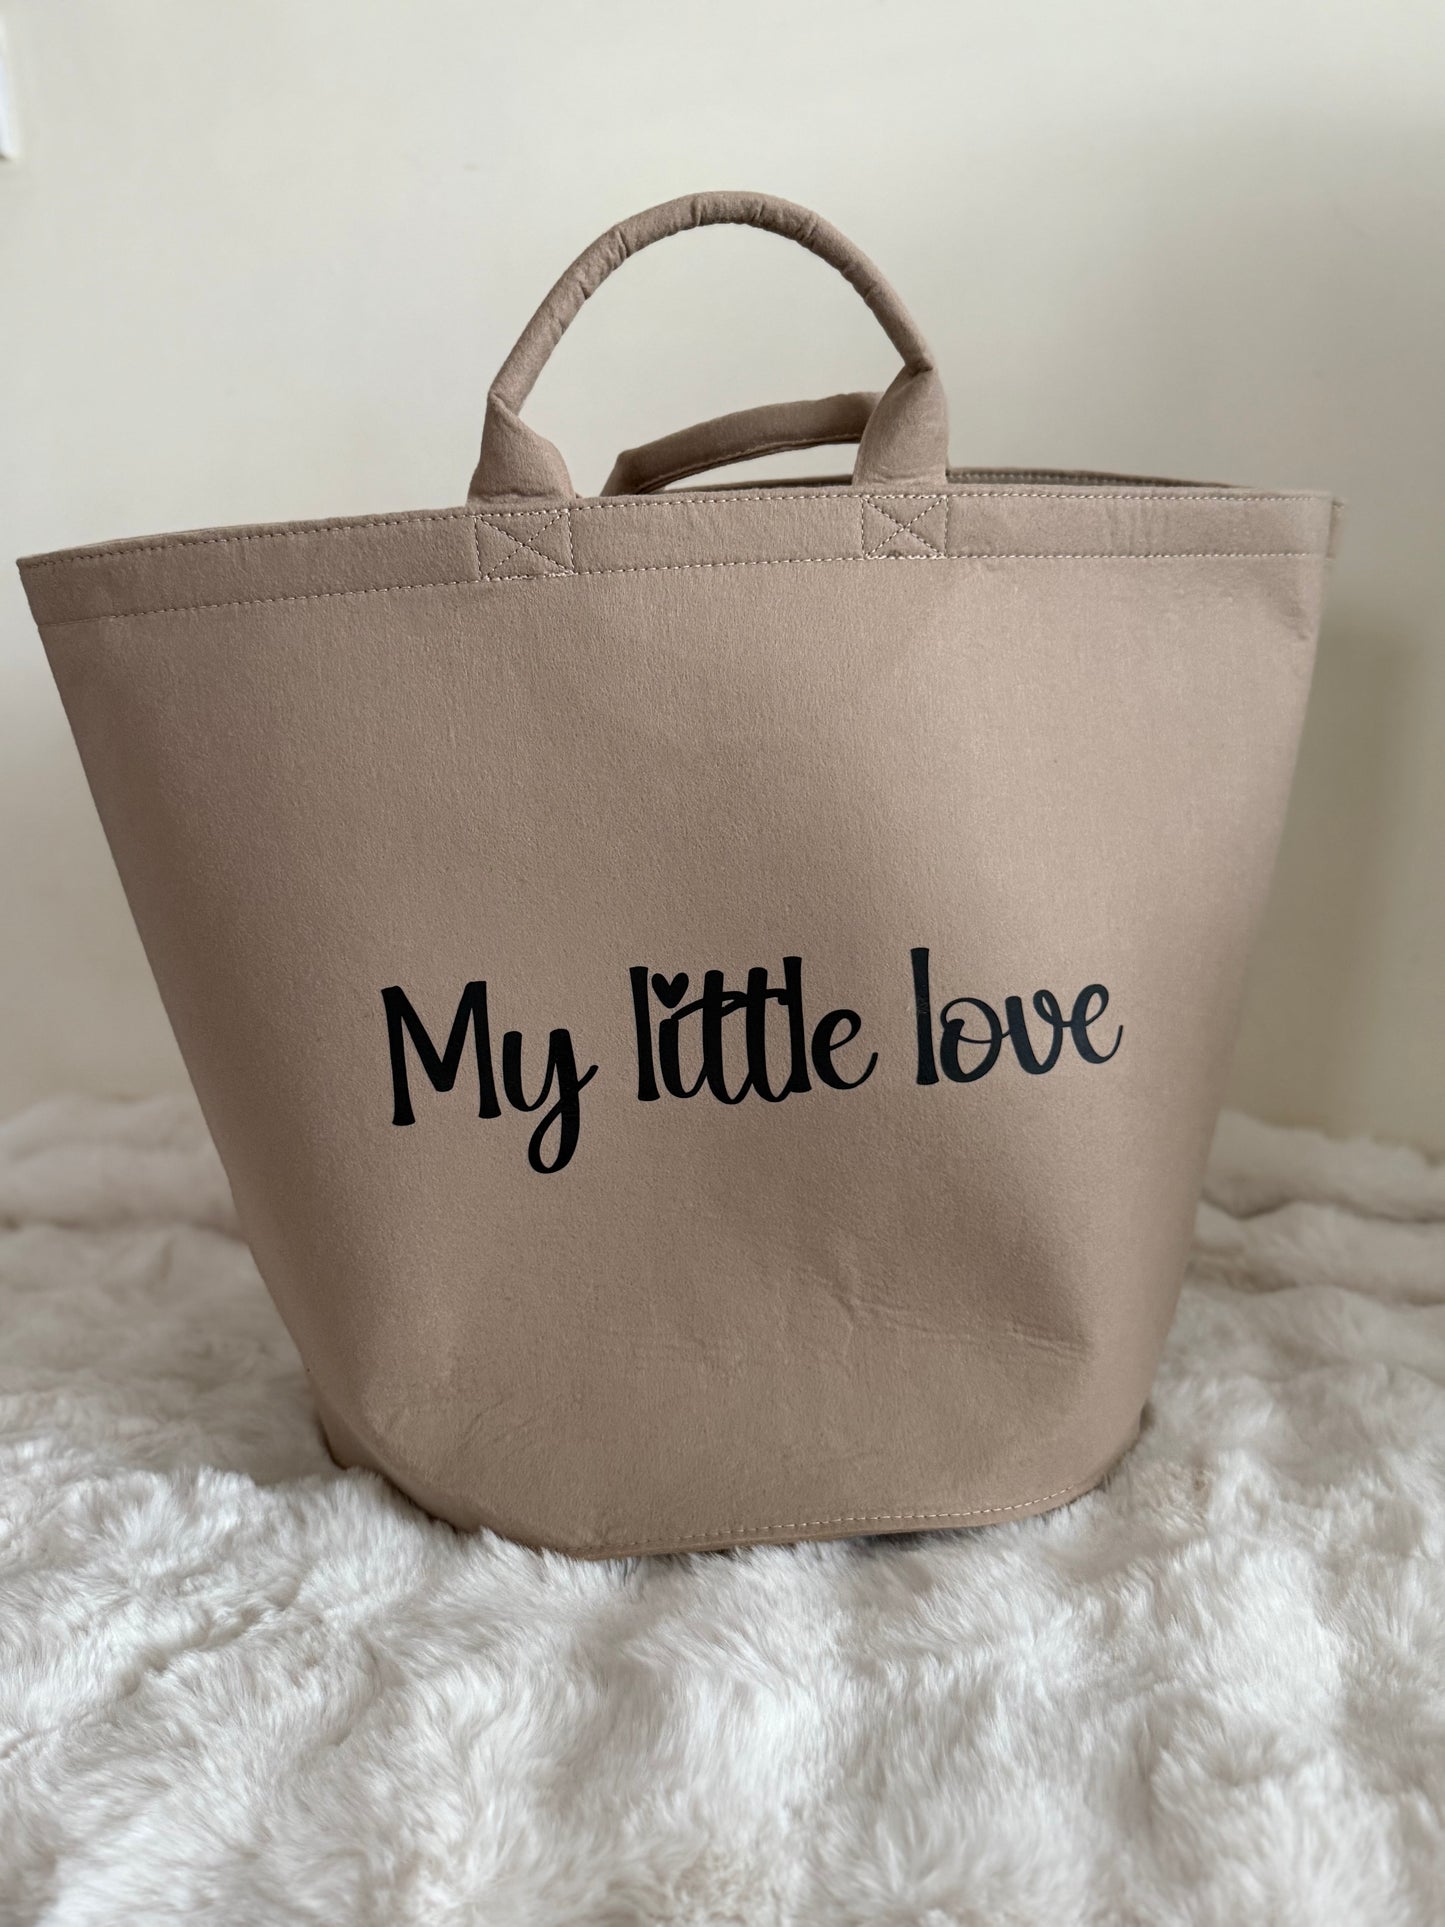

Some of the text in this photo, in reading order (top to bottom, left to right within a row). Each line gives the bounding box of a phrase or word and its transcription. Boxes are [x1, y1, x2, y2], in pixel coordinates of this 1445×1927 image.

[380, 947, 1124, 1175] My little love
